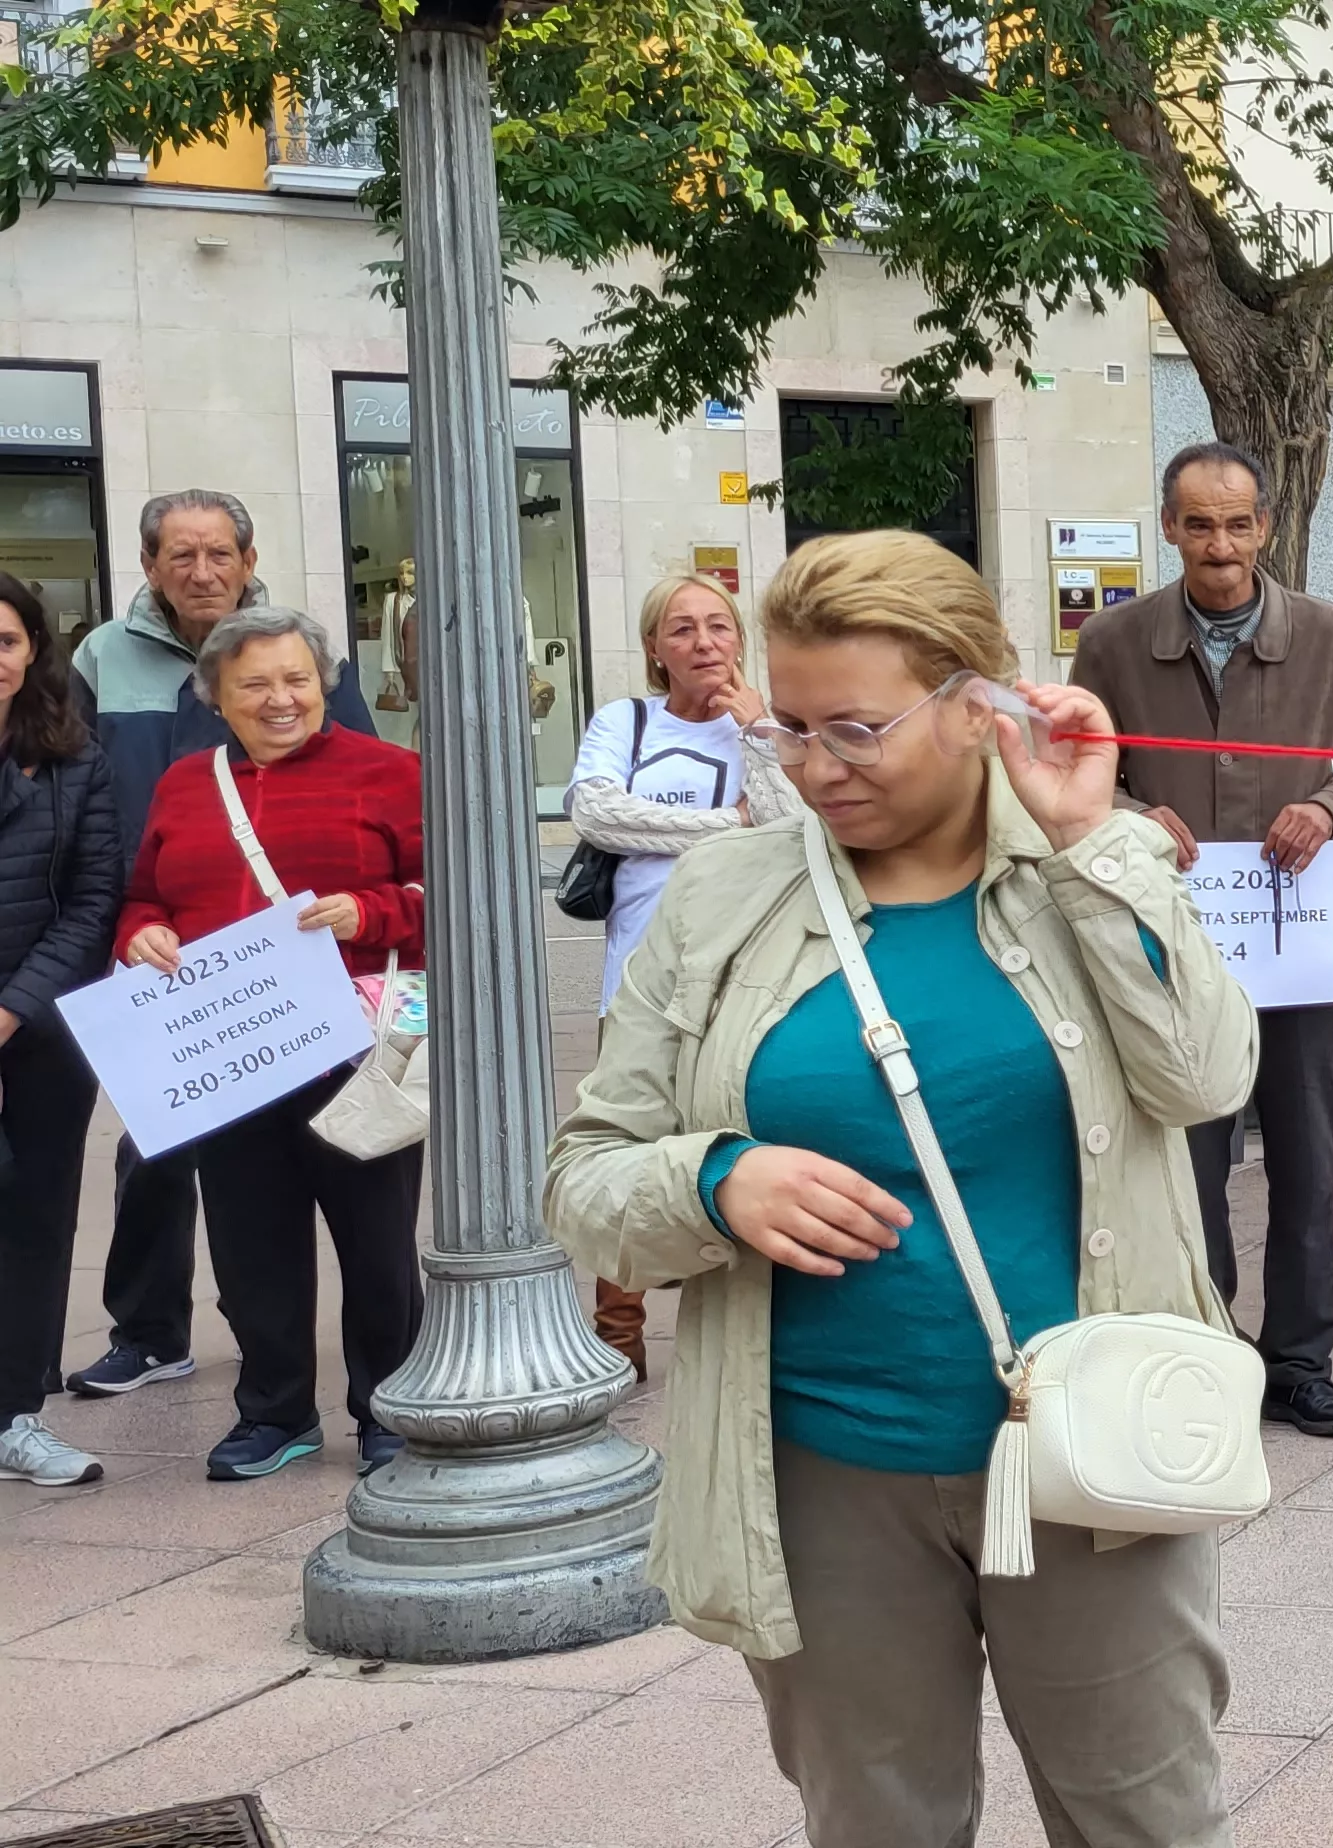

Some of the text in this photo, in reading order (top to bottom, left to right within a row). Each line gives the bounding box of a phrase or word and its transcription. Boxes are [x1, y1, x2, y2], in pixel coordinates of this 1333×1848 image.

[353, 397, 410, 428] Pil
[130, 936, 276, 1008] EN 2023 UNA
[164, 974, 279, 1035] HABITACIÓN
[163, 1020, 332, 1110] 280-300 EUROS
[171, 998, 299, 1065] UNA PERSONA
